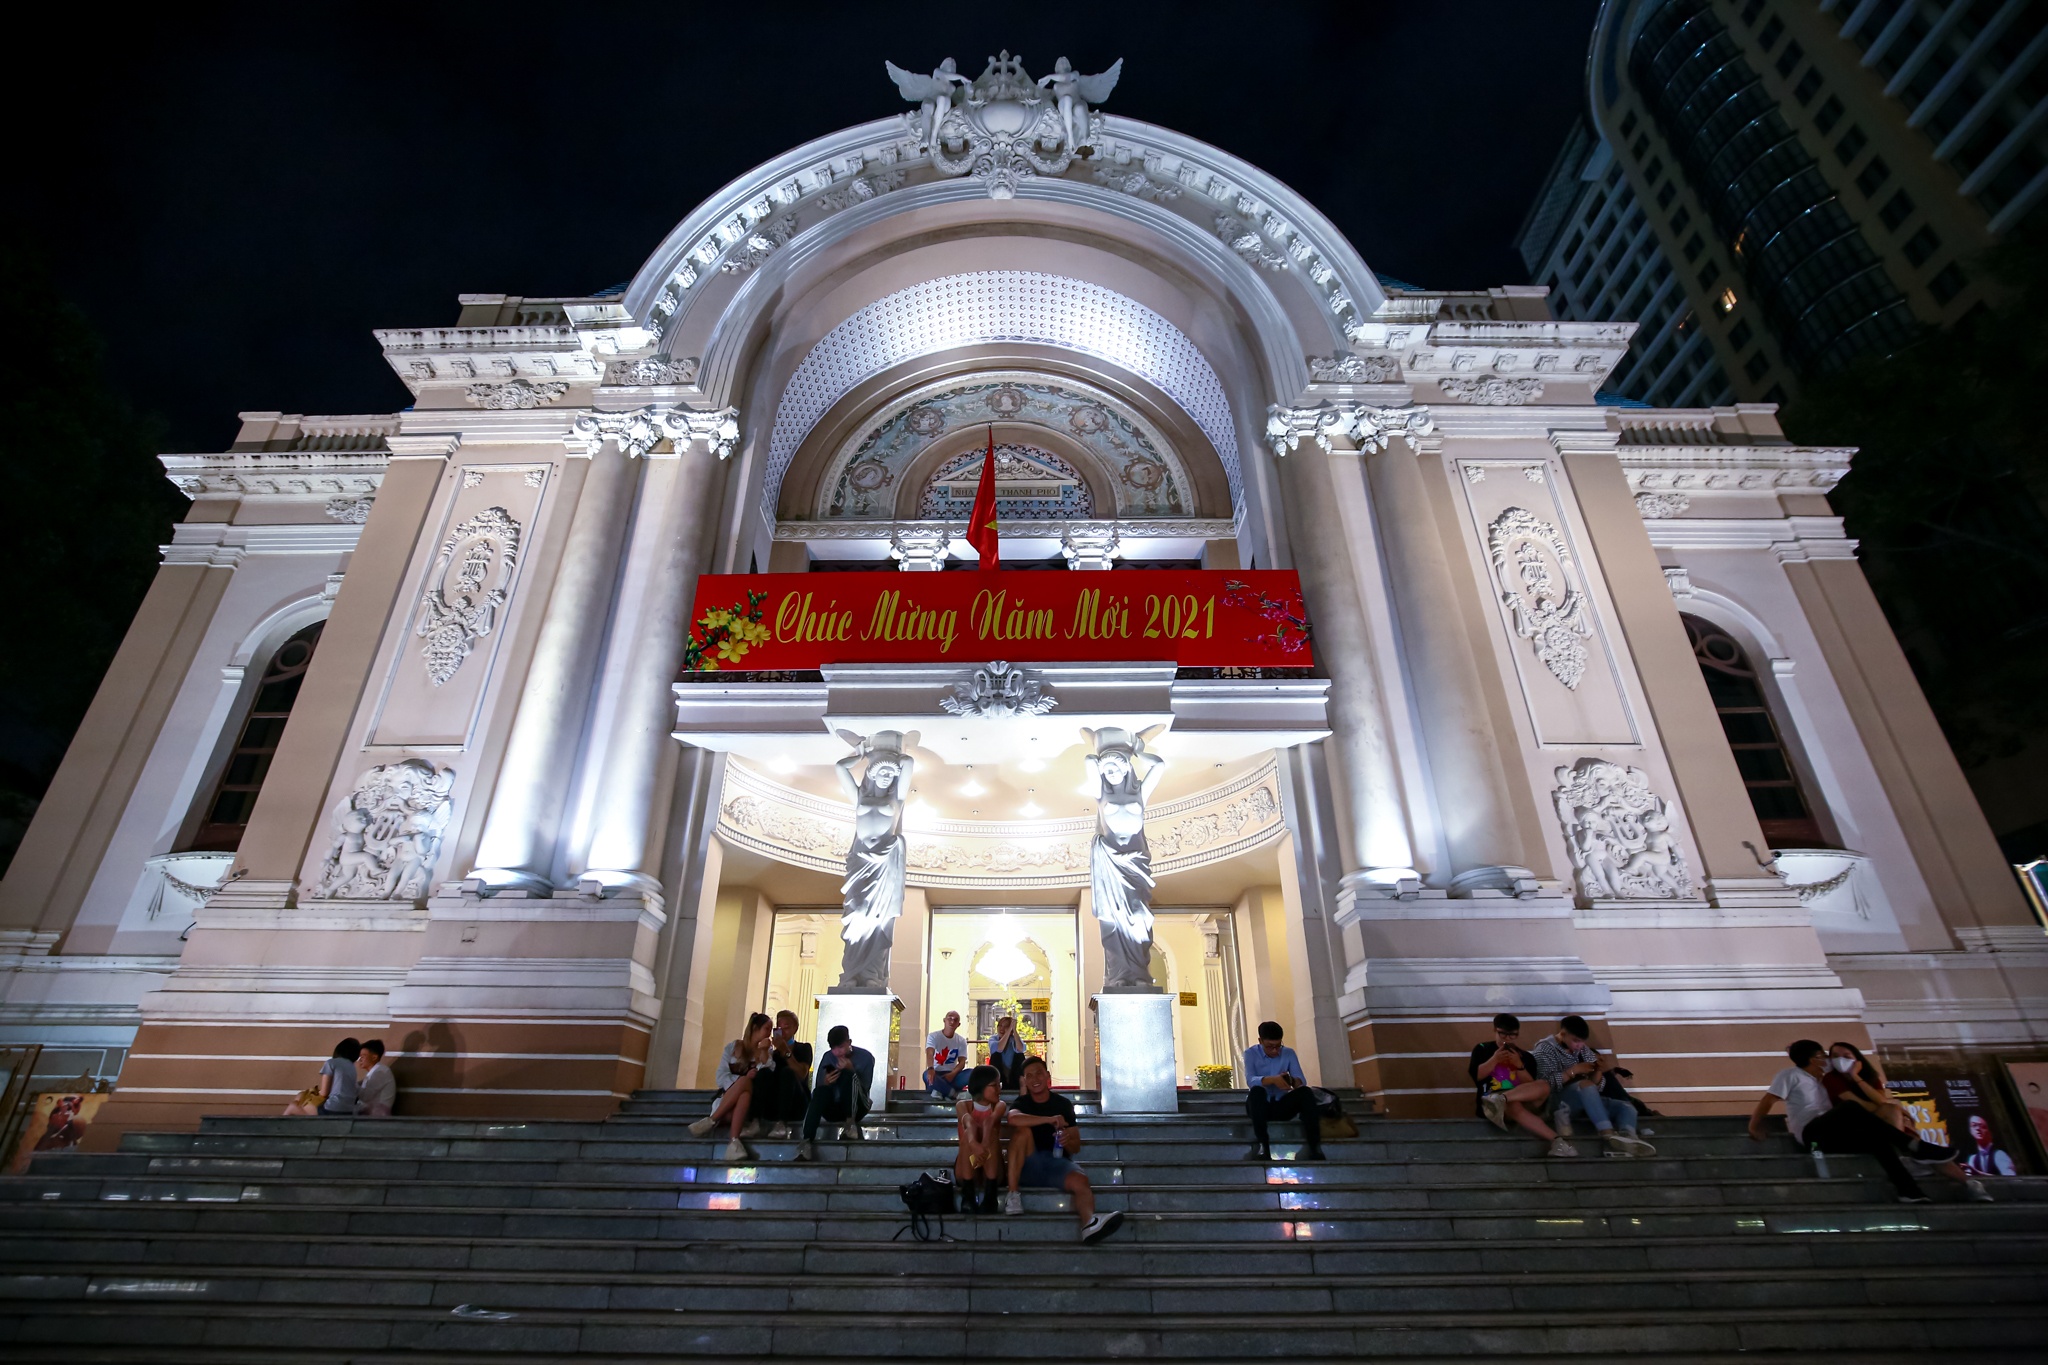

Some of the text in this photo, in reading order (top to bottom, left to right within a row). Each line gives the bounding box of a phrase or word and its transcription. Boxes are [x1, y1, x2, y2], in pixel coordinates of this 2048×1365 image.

[775, 588, 1215, 653] Chúc Mừng Năm Mới 2021
